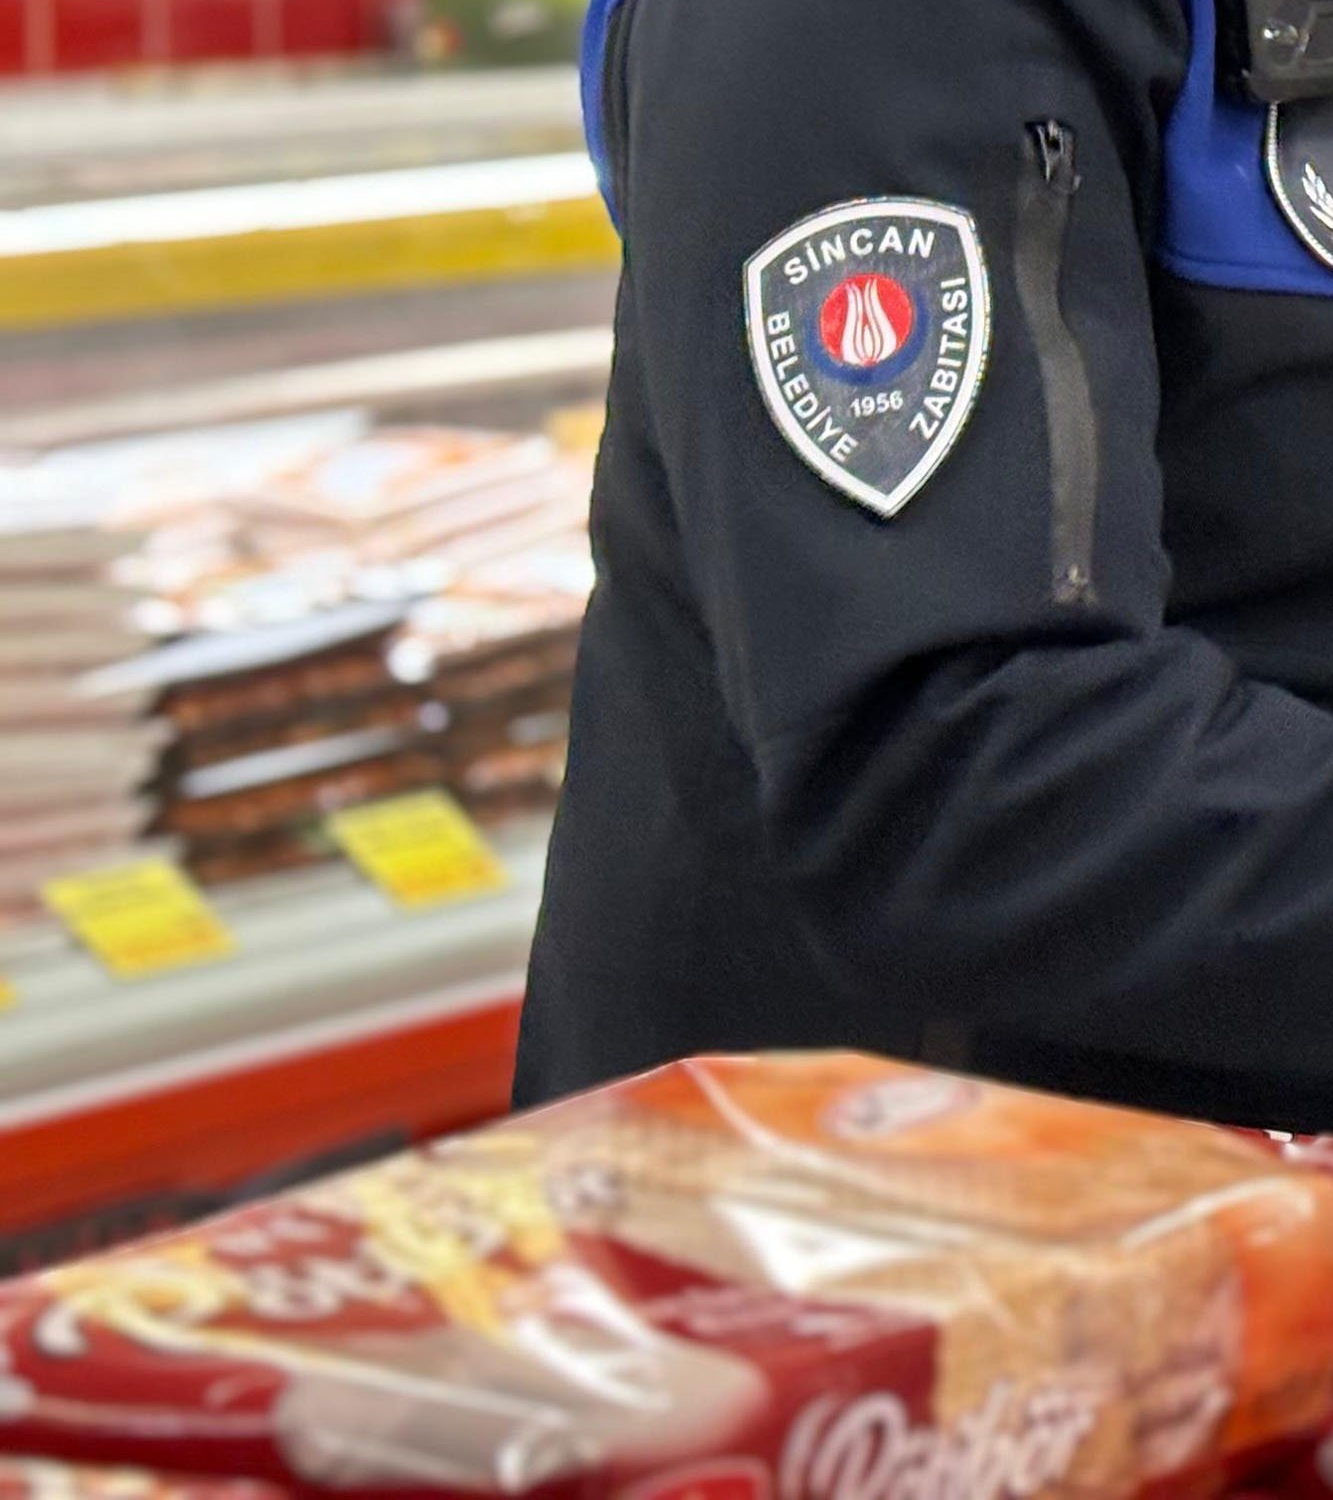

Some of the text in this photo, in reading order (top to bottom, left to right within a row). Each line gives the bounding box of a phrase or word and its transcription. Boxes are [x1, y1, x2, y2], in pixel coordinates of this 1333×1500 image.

[783, 225, 936, 286] SİNCAN
[767, 310, 859, 462] BELEDİYE
[909, 277, 968, 441] ZABITASI
